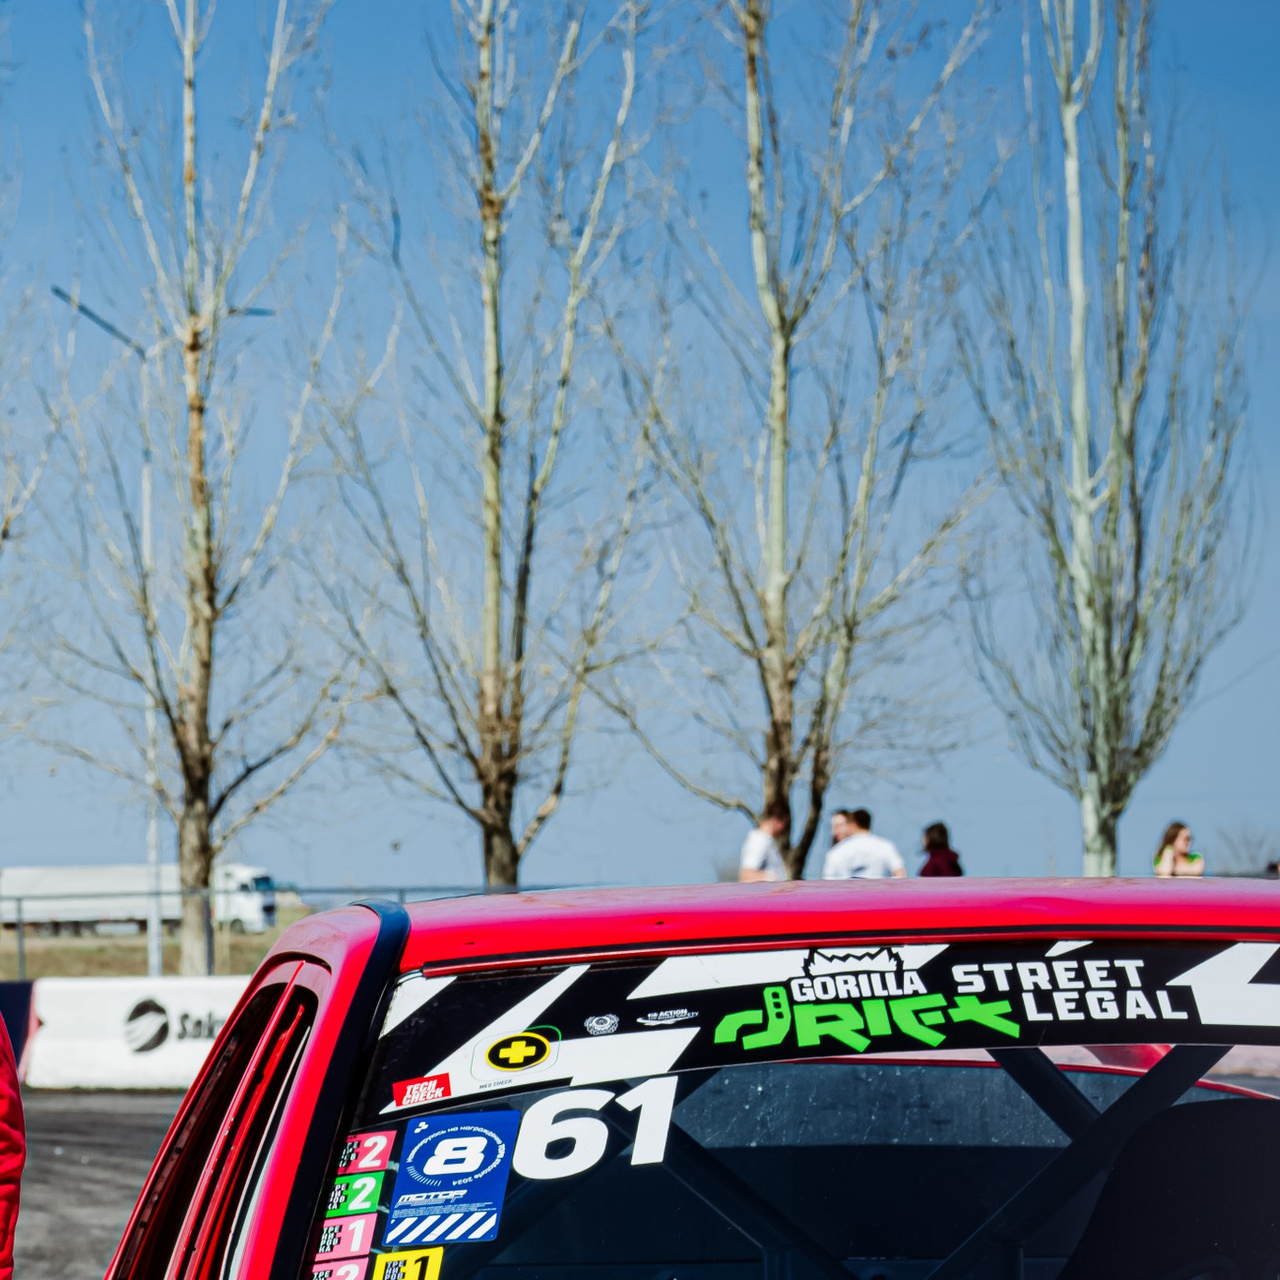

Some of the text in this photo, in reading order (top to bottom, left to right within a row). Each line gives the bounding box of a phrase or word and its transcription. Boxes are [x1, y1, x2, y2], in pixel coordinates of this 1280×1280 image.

[791, 970, 928, 1003] GORILLA
[952, 959, 1145, 994] STREET
[659, 1008, 688, 1018] ACTION
[1022, 989, 1189, 1022] LEGAL
[401, 1087, 445, 1106] CHECK
[406, 1079, 438, 1096] TECH
[493, 1079, 513, 1088] CHECK
[512, 1075, 678, 1180] 61
[358, 1135, 388, 1169] 2
[423, 1136, 488, 1176] 8
[348, 1176, 377, 1211] 2
[452, 1176, 474, 1186] 2024
[348, 1219, 365, 1252] 1
